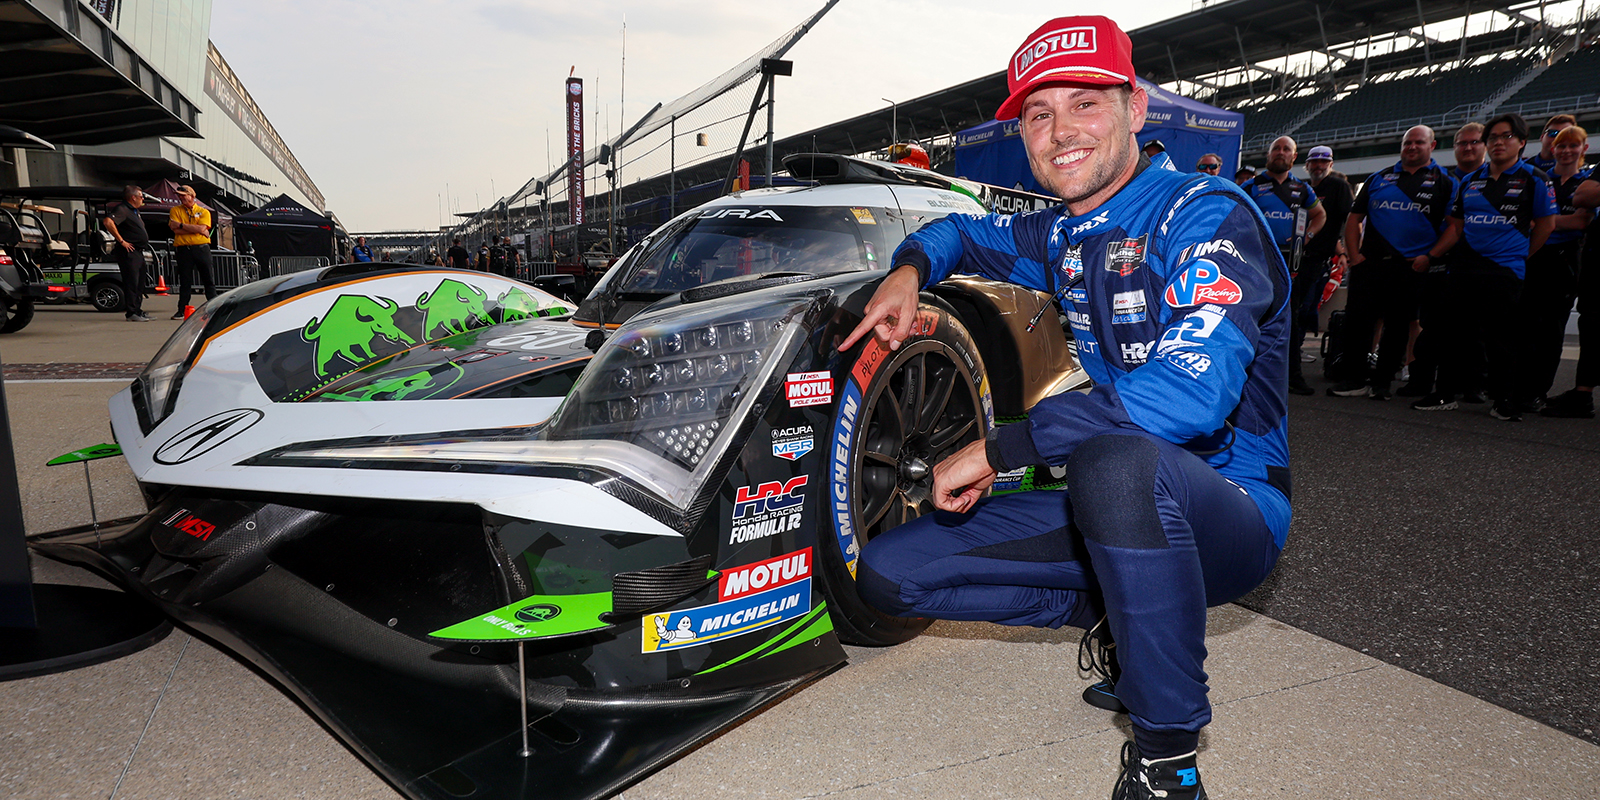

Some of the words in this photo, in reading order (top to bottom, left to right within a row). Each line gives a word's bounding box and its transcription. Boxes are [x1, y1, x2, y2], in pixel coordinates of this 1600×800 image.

[1020, 32, 1090, 71] MOTUL
[573, 102, 581, 131] BRICKS
[1198, 118, 1238, 128] MICHELIN
[966, 131, 995, 143] MICHELIN
[179, 170, 189, 179] 36
[994, 194, 1031, 212] ACURA
[1378, 200, 1431, 214] ACURA
[1466, 215, 1518, 225] ACURA
[1171, 258, 1221, 307] VP
[1197, 288, 1240, 302] Racing
[788, 381, 833, 398] MOTUL
[779, 425, 814, 437] ACURA
[774, 440, 813, 454] MSR
[835, 394, 859, 537] MICHELIN
[732, 474, 809, 519] HRC
[732, 514, 769, 527] Honda
[769, 505, 804, 519] RACING
[729, 516, 787, 545] FORMULA
[786, 512, 803, 532] R
[723, 552, 809, 597] MOTUL
[483, 615, 509, 626] ONLY
[699, 592, 801, 633] MICHELIN
